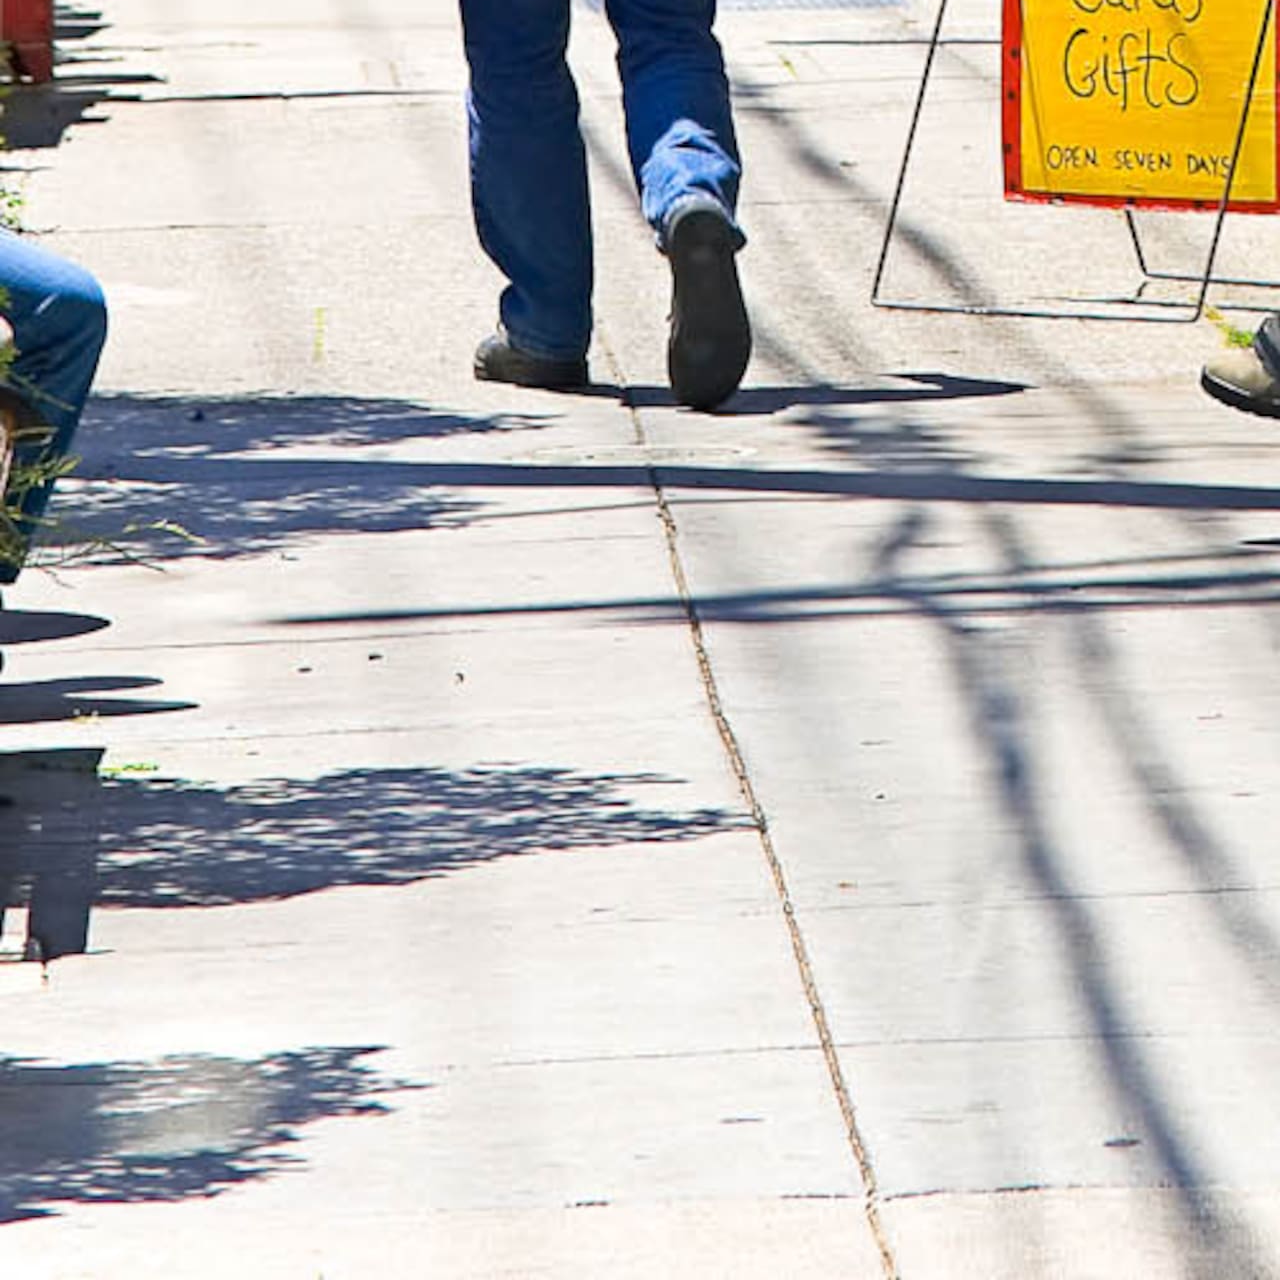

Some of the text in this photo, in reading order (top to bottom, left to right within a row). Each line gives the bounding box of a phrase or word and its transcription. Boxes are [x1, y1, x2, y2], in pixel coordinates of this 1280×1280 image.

[1063, 28, 1200, 112] Gifts
[1047, 145, 1232, 179] OPEN SEVEN DAYS
